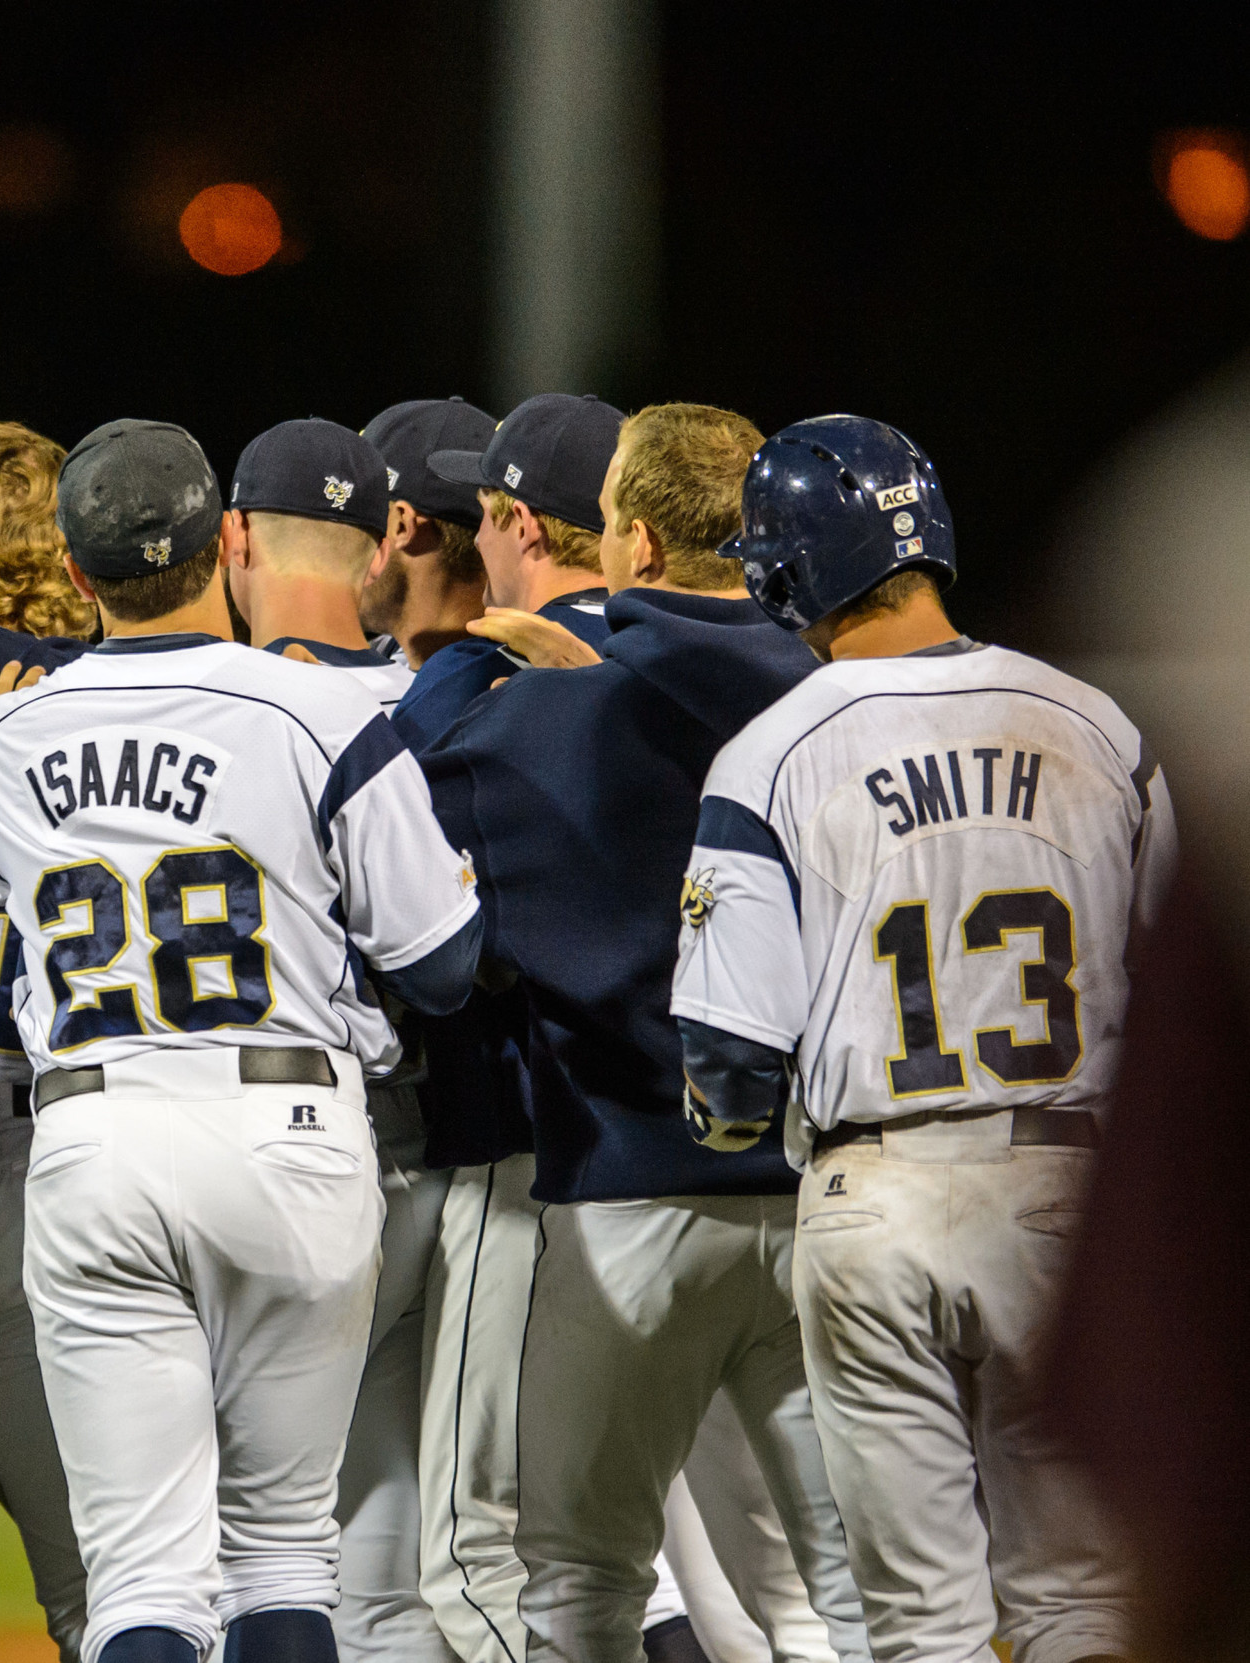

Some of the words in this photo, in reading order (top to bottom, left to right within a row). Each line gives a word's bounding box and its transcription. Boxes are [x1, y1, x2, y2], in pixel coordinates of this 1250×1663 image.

[882, 487, 913, 508] ACC
[25, 739, 217, 830] ISAACS
[865, 748, 1041, 837] SMITH
[33, 844, 277, 1056] 28
[872, 885, 1084, 1101] 13
[287, 1124, 327, 1132] RUSSELL
[292, 1105, 316, 1124] R
